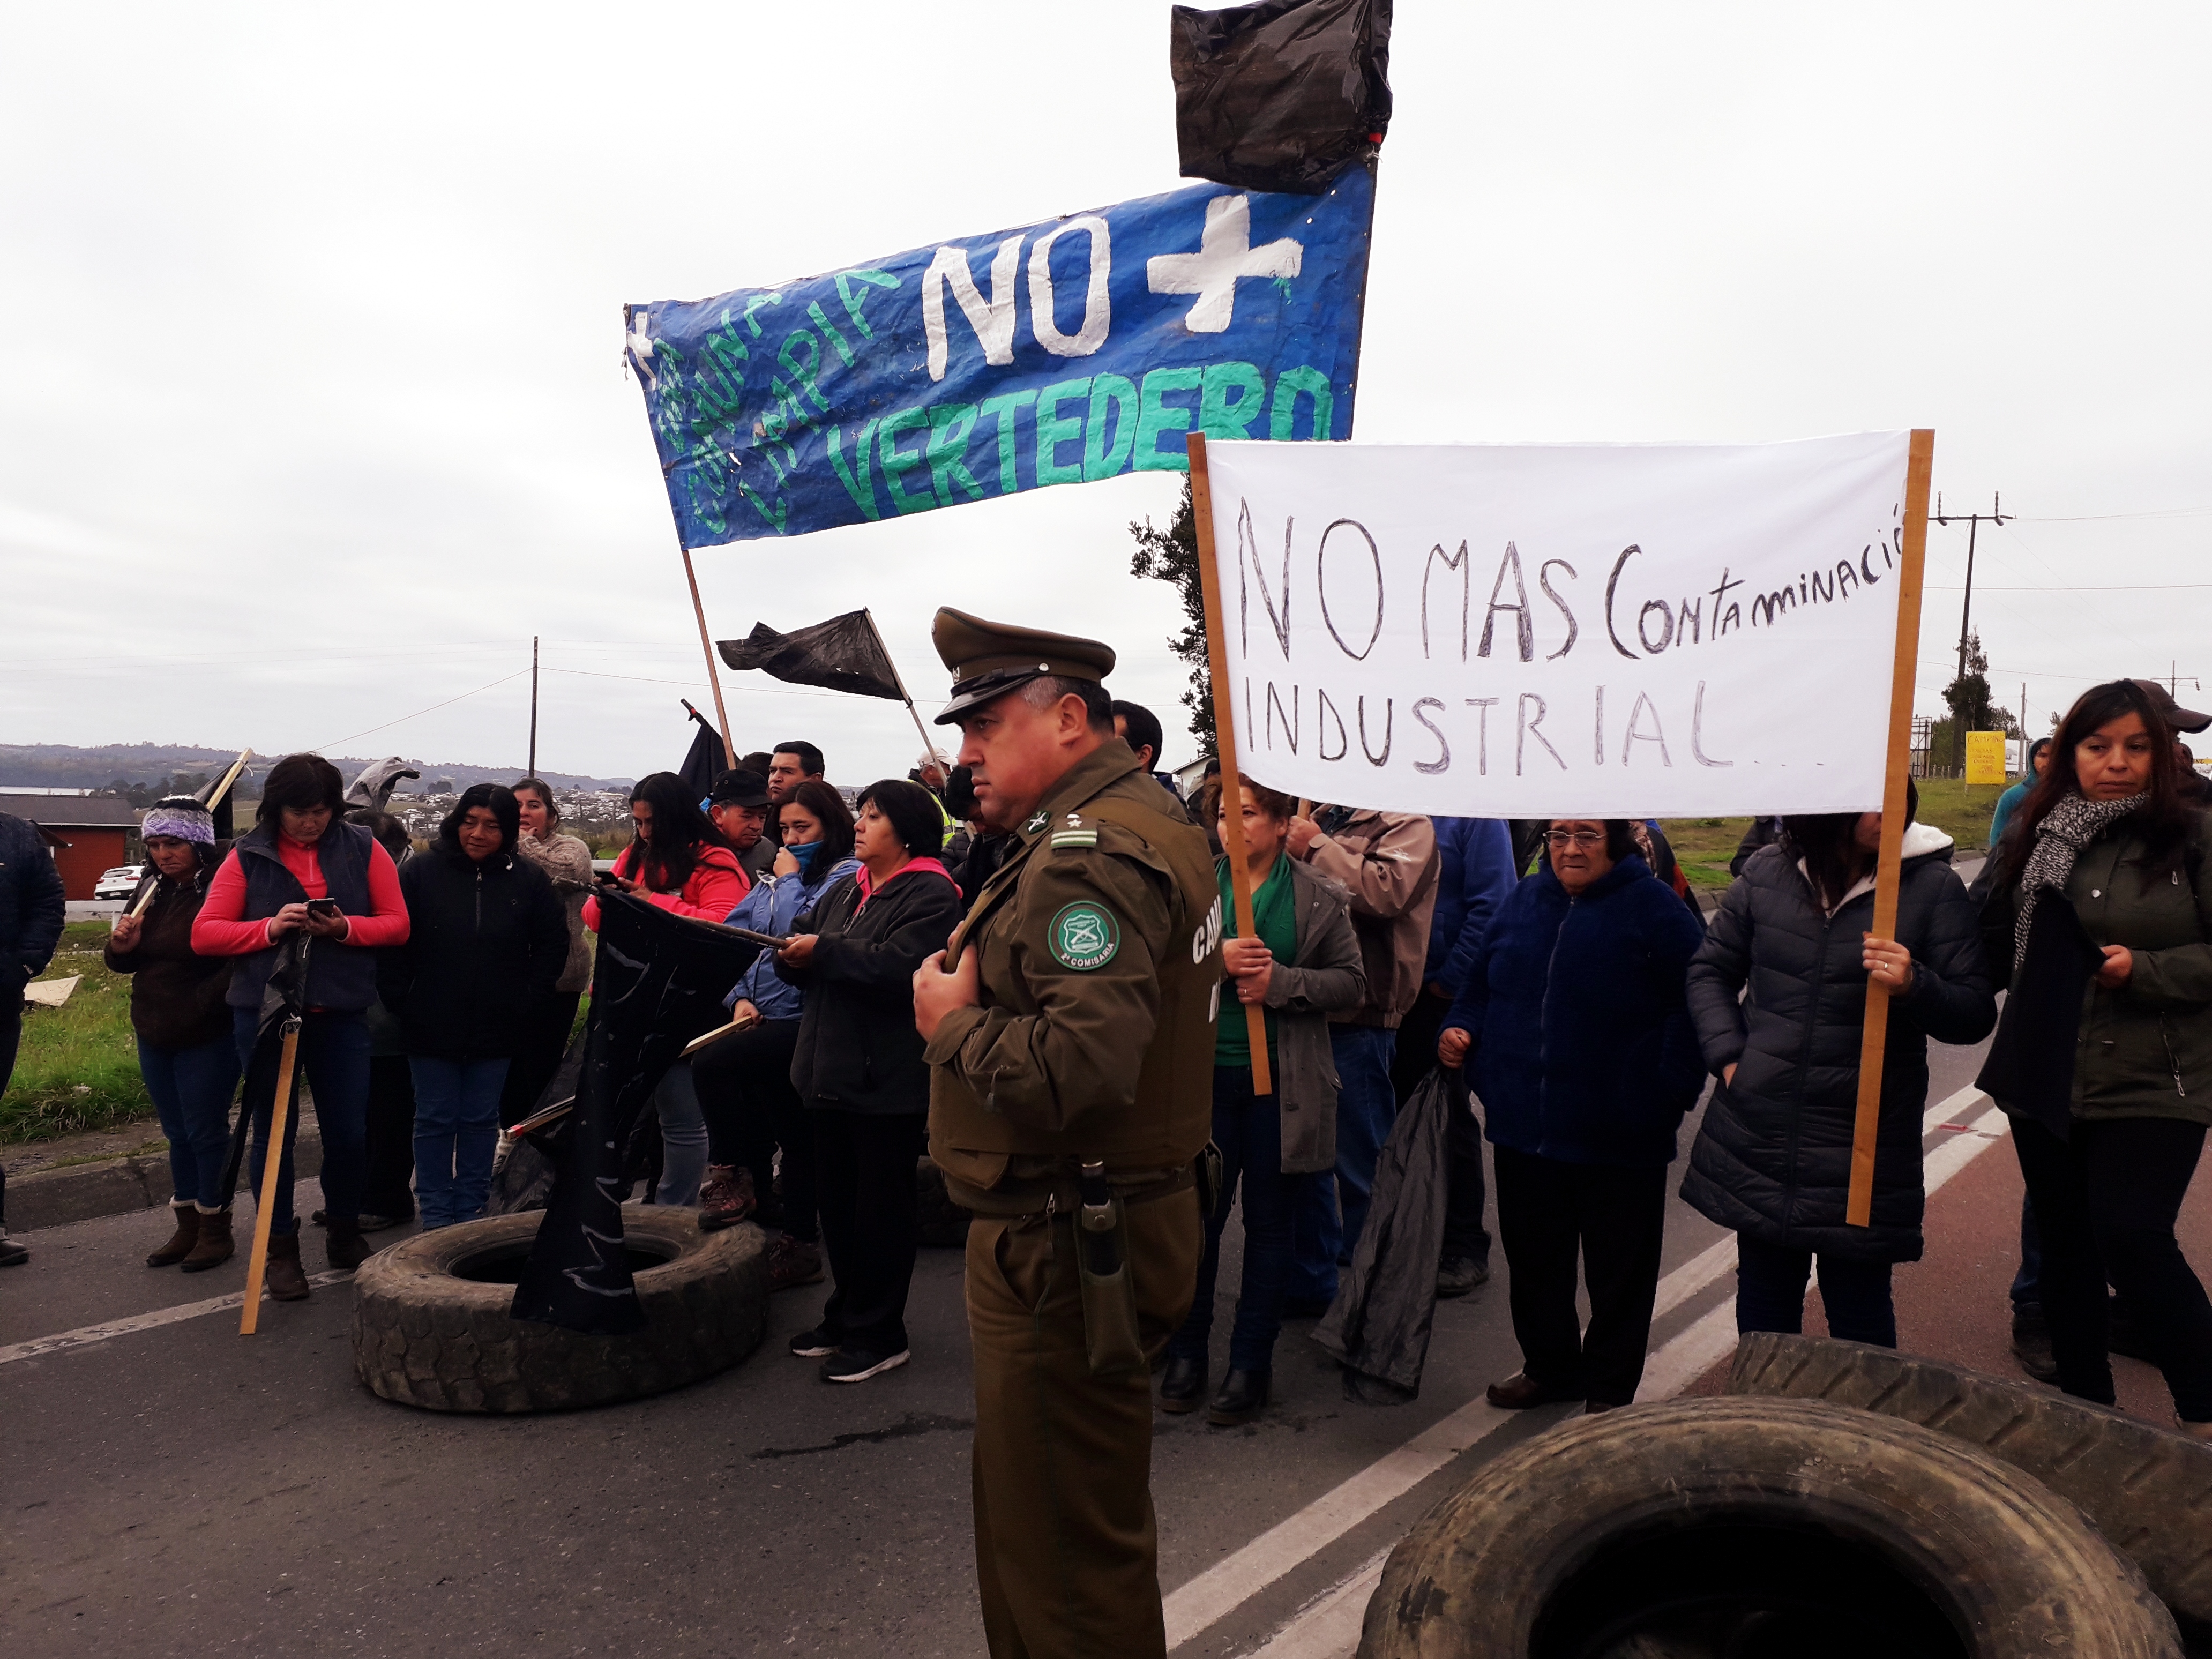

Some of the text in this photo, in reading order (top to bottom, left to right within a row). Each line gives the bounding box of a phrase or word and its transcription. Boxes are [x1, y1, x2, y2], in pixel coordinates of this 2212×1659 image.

[923, 215, 1111, 382] NO
[826, 361, 1334, 523] VERTEDERO
[1238, 496, 1385, 663] NO
[1421, 538, 1579, 666] MAS
[1071, 941, 1115, 967] COMISARIA
